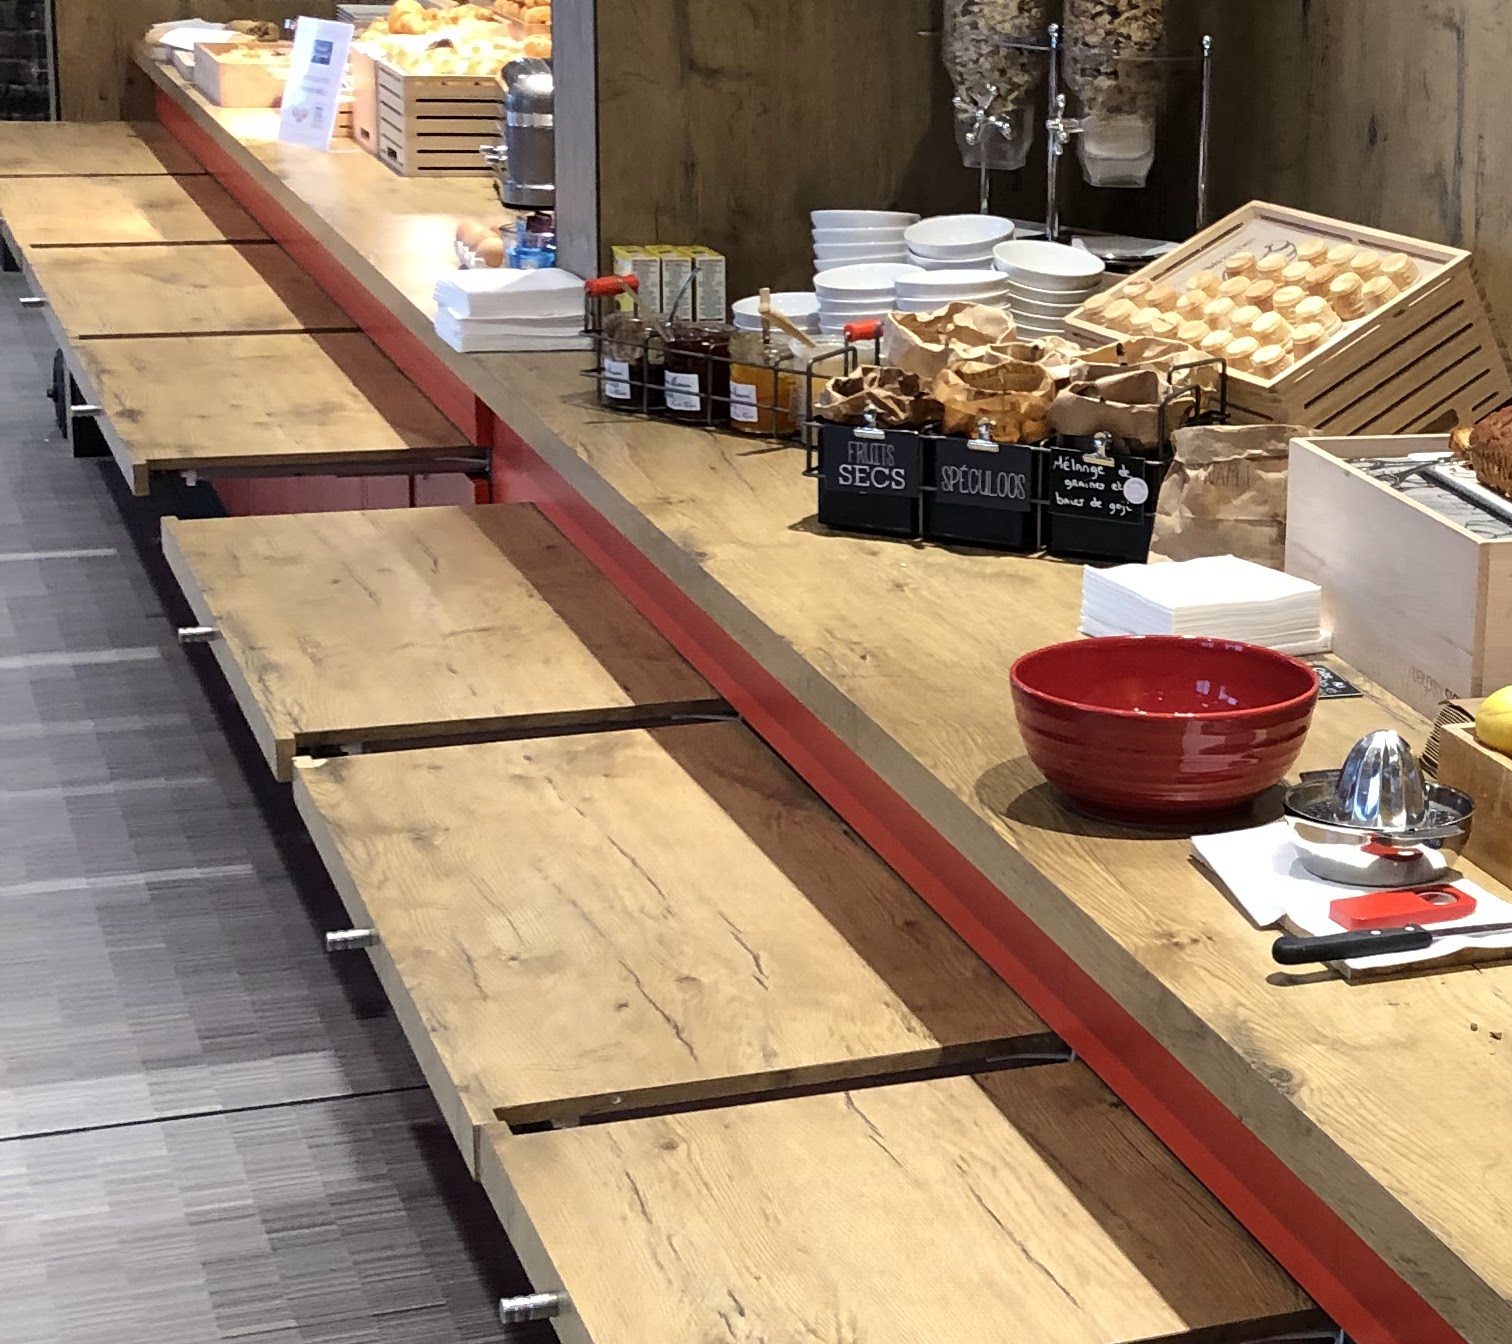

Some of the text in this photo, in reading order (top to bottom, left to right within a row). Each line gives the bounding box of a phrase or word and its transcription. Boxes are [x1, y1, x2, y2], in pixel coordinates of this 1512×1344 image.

[847, 440, 896, 467] FRUITS
[838, 463, 906, 490] SECS
[940, 464, 1026, 500] SPÉCULOOS
